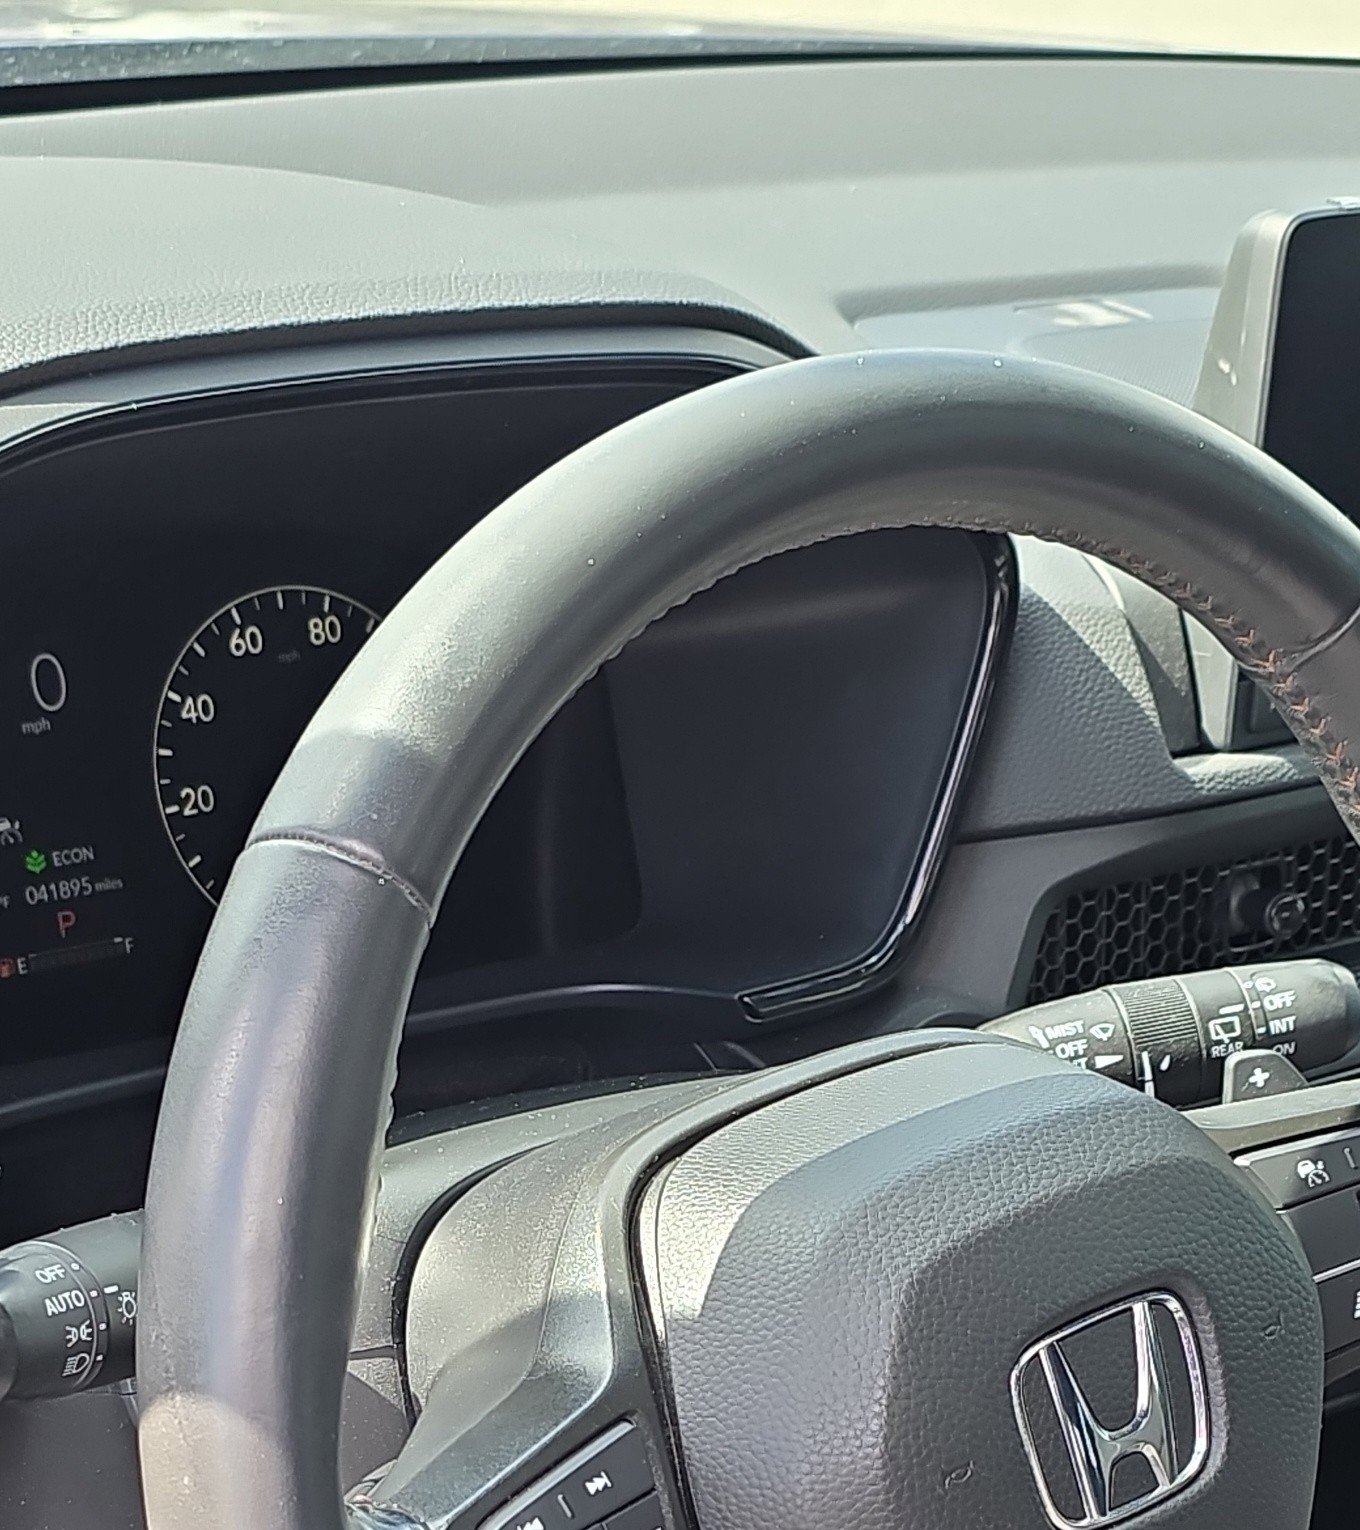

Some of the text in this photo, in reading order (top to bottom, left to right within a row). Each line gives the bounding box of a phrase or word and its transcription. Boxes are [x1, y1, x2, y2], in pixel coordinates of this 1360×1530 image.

[307, 614, 342, 647] 80
[228, 625, 264, 658] 60
[30, 652, 67, 712] 0
[180, 694, 215, 724] 40
[21, 717, 51, 735] mph
[179, 785, 215, 817] 20
[52, 846, 95, 868] ECON
[25, 876, 124, 905] 041895 miles
[56, 910, 77, 939] P
[124, 937, 134, 954] F
[16, 956, 28, 975] E
[1263, 990, 1296, 1011] OFF
[1045, 1020, 1084, 1040] MIST
[1269, 1016, 1296, 1035] INT
[1055, 1039, 1088, 1059] OFF
[1211, 1041, 1244, 1059] REAR
[35, 1264, 66, 1284] OFF
[44, 1289, 86, 1317] AUTO
